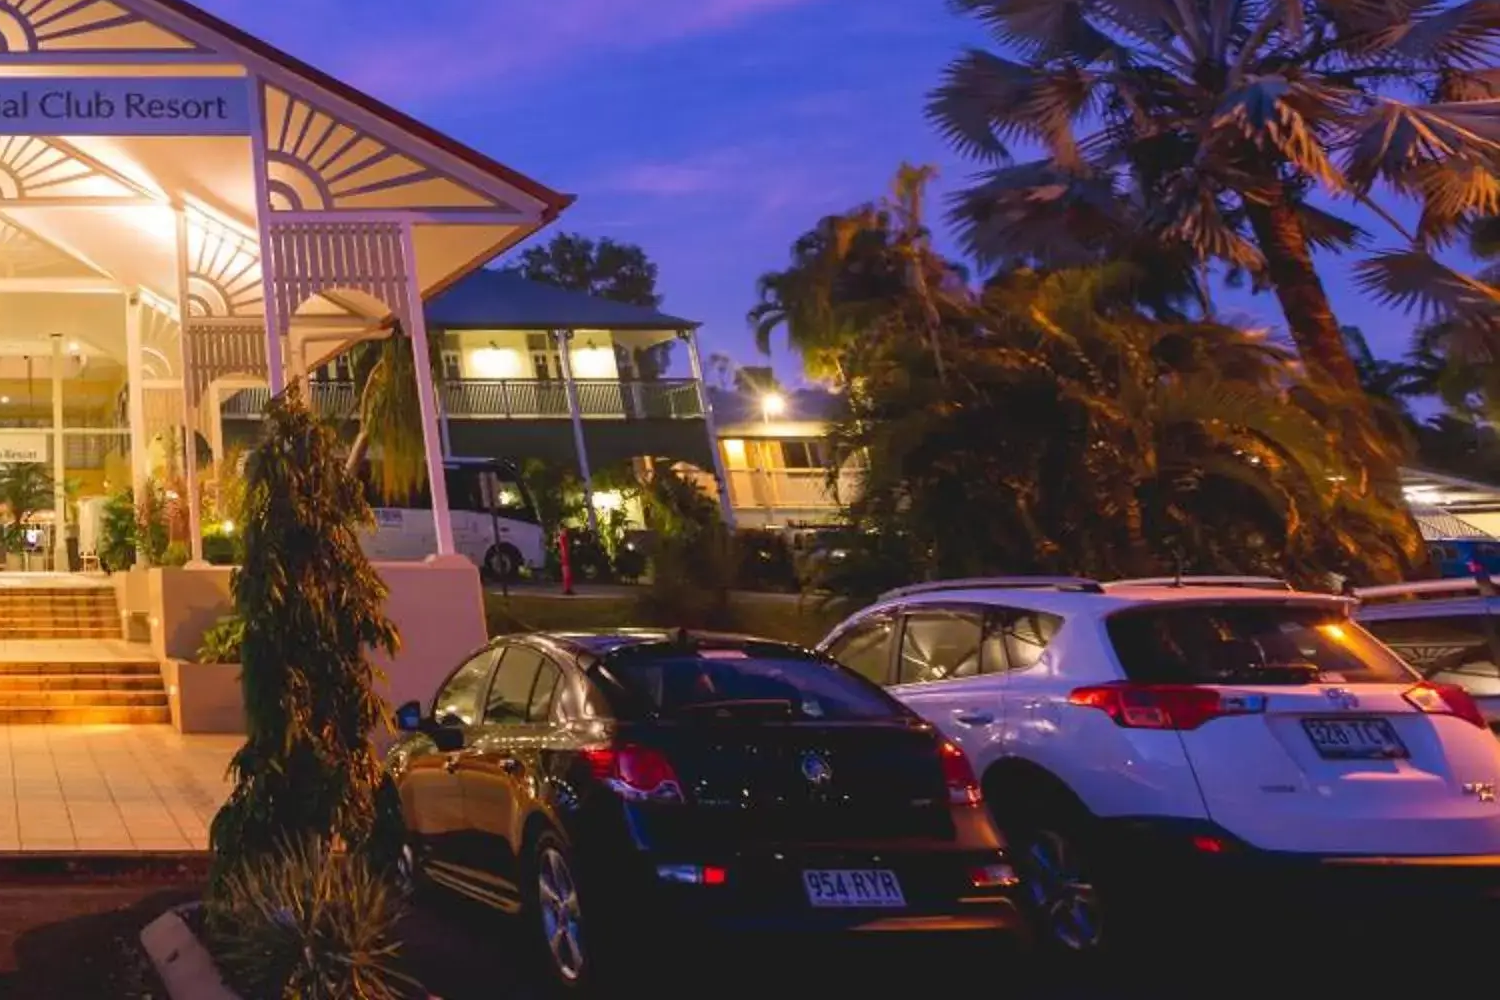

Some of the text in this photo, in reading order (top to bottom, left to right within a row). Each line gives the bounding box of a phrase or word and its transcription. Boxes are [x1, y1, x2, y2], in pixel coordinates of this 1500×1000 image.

[38, 90, 115, 119] Club
[124, 92, 229, 119] Resort
[3, 449, 37, 460] Resort
